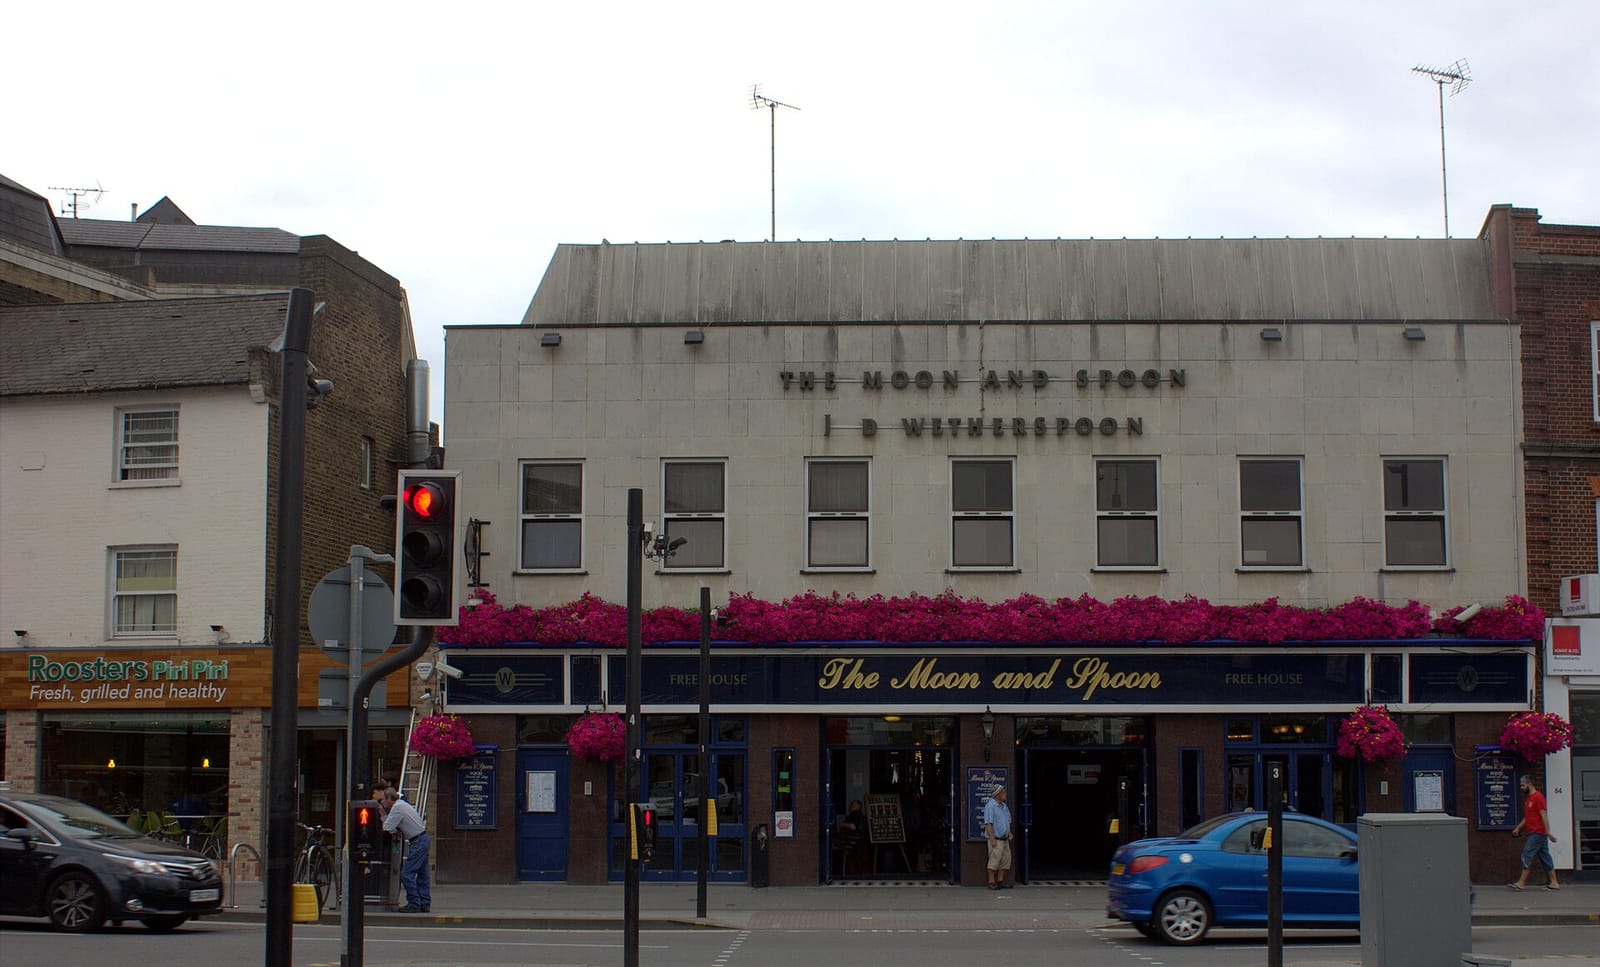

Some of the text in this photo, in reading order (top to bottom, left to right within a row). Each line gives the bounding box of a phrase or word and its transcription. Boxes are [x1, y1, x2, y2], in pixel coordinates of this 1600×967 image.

[780, 369, 1186, 390] THE MOON AND SPOON
[862, 418, 878, 437] D
[902, 416, 1143, 437] WETHERSPOON
[28, 655, 229, 682] Roosters Piri Piri
[670, 673, 698, 685] FREE
[818, 656, 1162, 702] The Moon and Spoon
[1225, 672, 1304, 685] FREE HOUSE
[29, 682, 227, 704] Fresh, grilled and healthy
[362, 697, 369, 710] 5
[628, 713, 636, 726] 4
[1272, 767, 1280, 779] 3
[1120, 781, 1127, 790] 2
